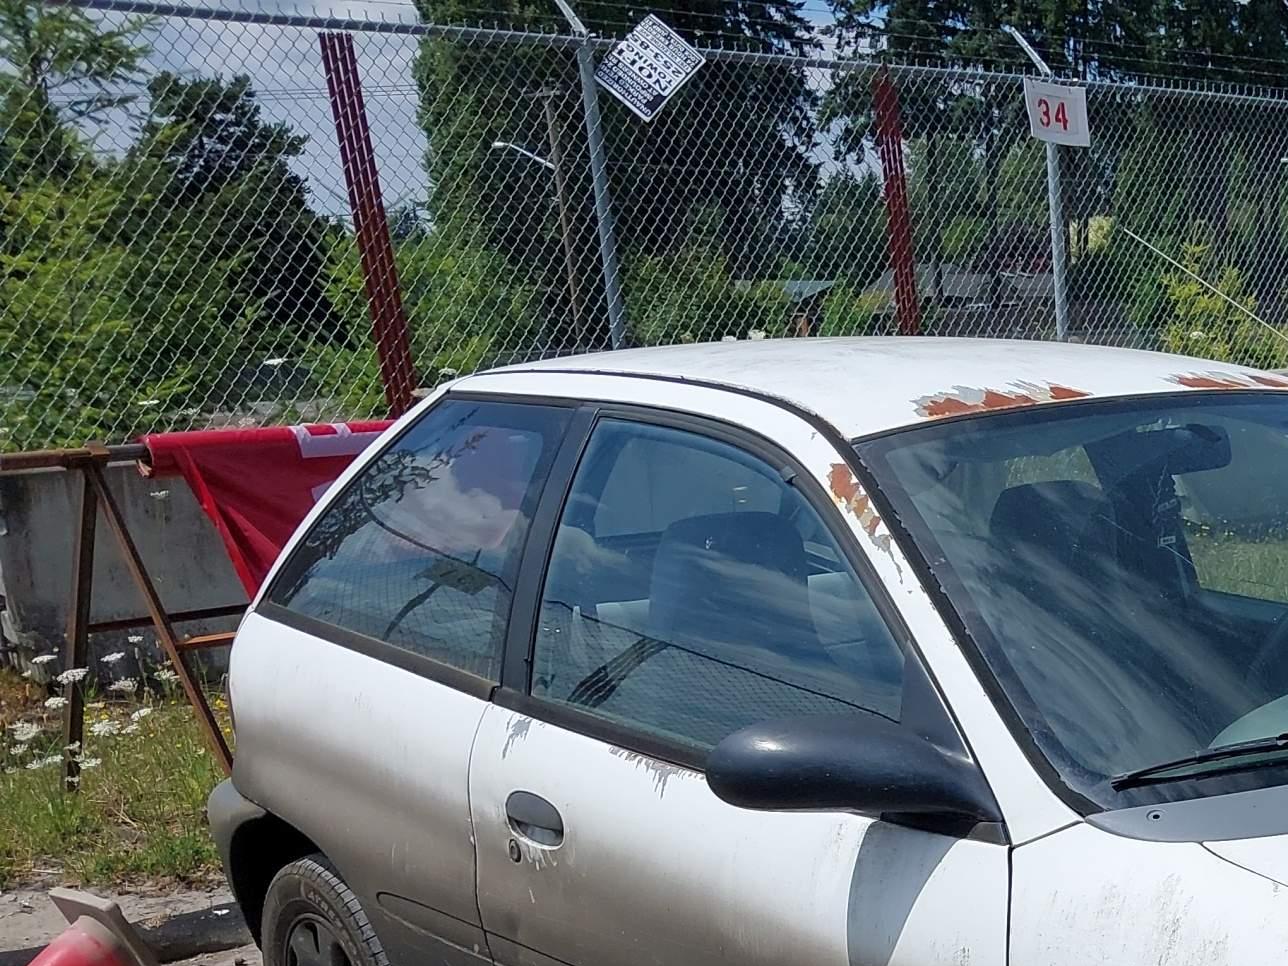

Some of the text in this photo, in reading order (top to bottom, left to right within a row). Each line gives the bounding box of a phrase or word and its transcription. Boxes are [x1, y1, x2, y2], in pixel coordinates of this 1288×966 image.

[623, 42, 675, 86] TOWING
[596, 69, 652, 116] UNAUTHORIZED
[1038, 98, 1068, 130] 34
